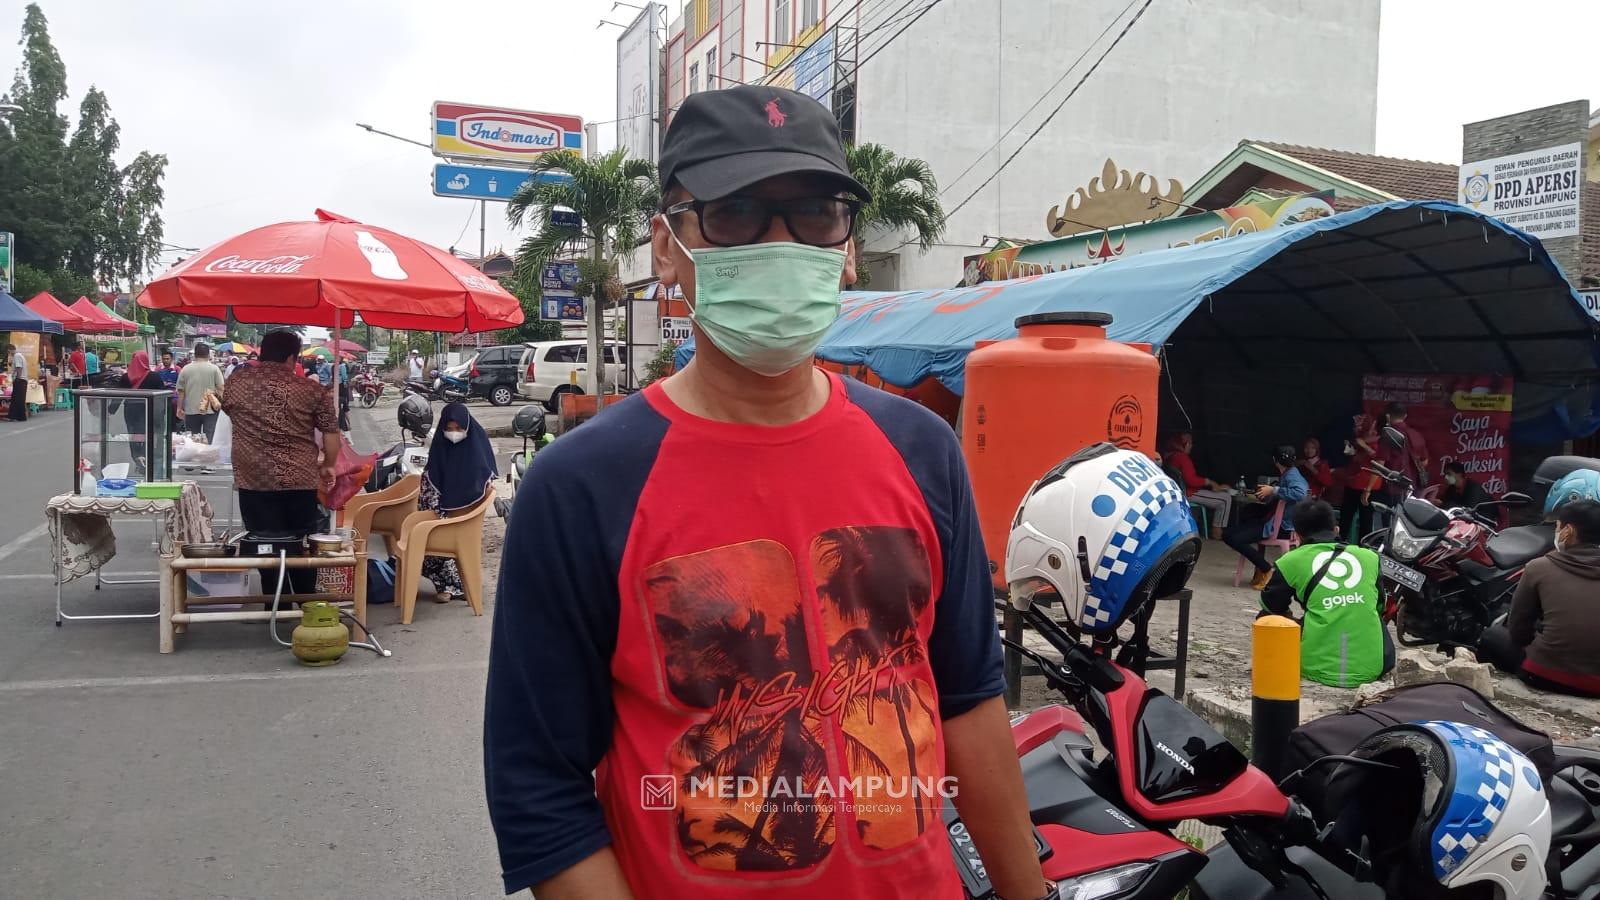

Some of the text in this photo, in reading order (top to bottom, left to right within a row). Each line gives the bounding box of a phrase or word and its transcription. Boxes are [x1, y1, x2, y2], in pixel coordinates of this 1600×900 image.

[467, 122, 555, 146] Indomaret
[1495, 151, 1578, 172] DEWAN PENGURUS DAERAH
[1494, 170, 1577, 200] DPD APERSI
[1494, 190, 1577, 211] PROVINSI LAMPUNG
[1586, 294, 1600, 310] DI
[663, 328, 694, 339] DIJU
[1450, 412, 1491, 435] Saya
[1457, 430, 1505, 453] Sudah
[1322, 592, 1365, 609] gojek
[1156, 741, 1195, 776] HONDA
